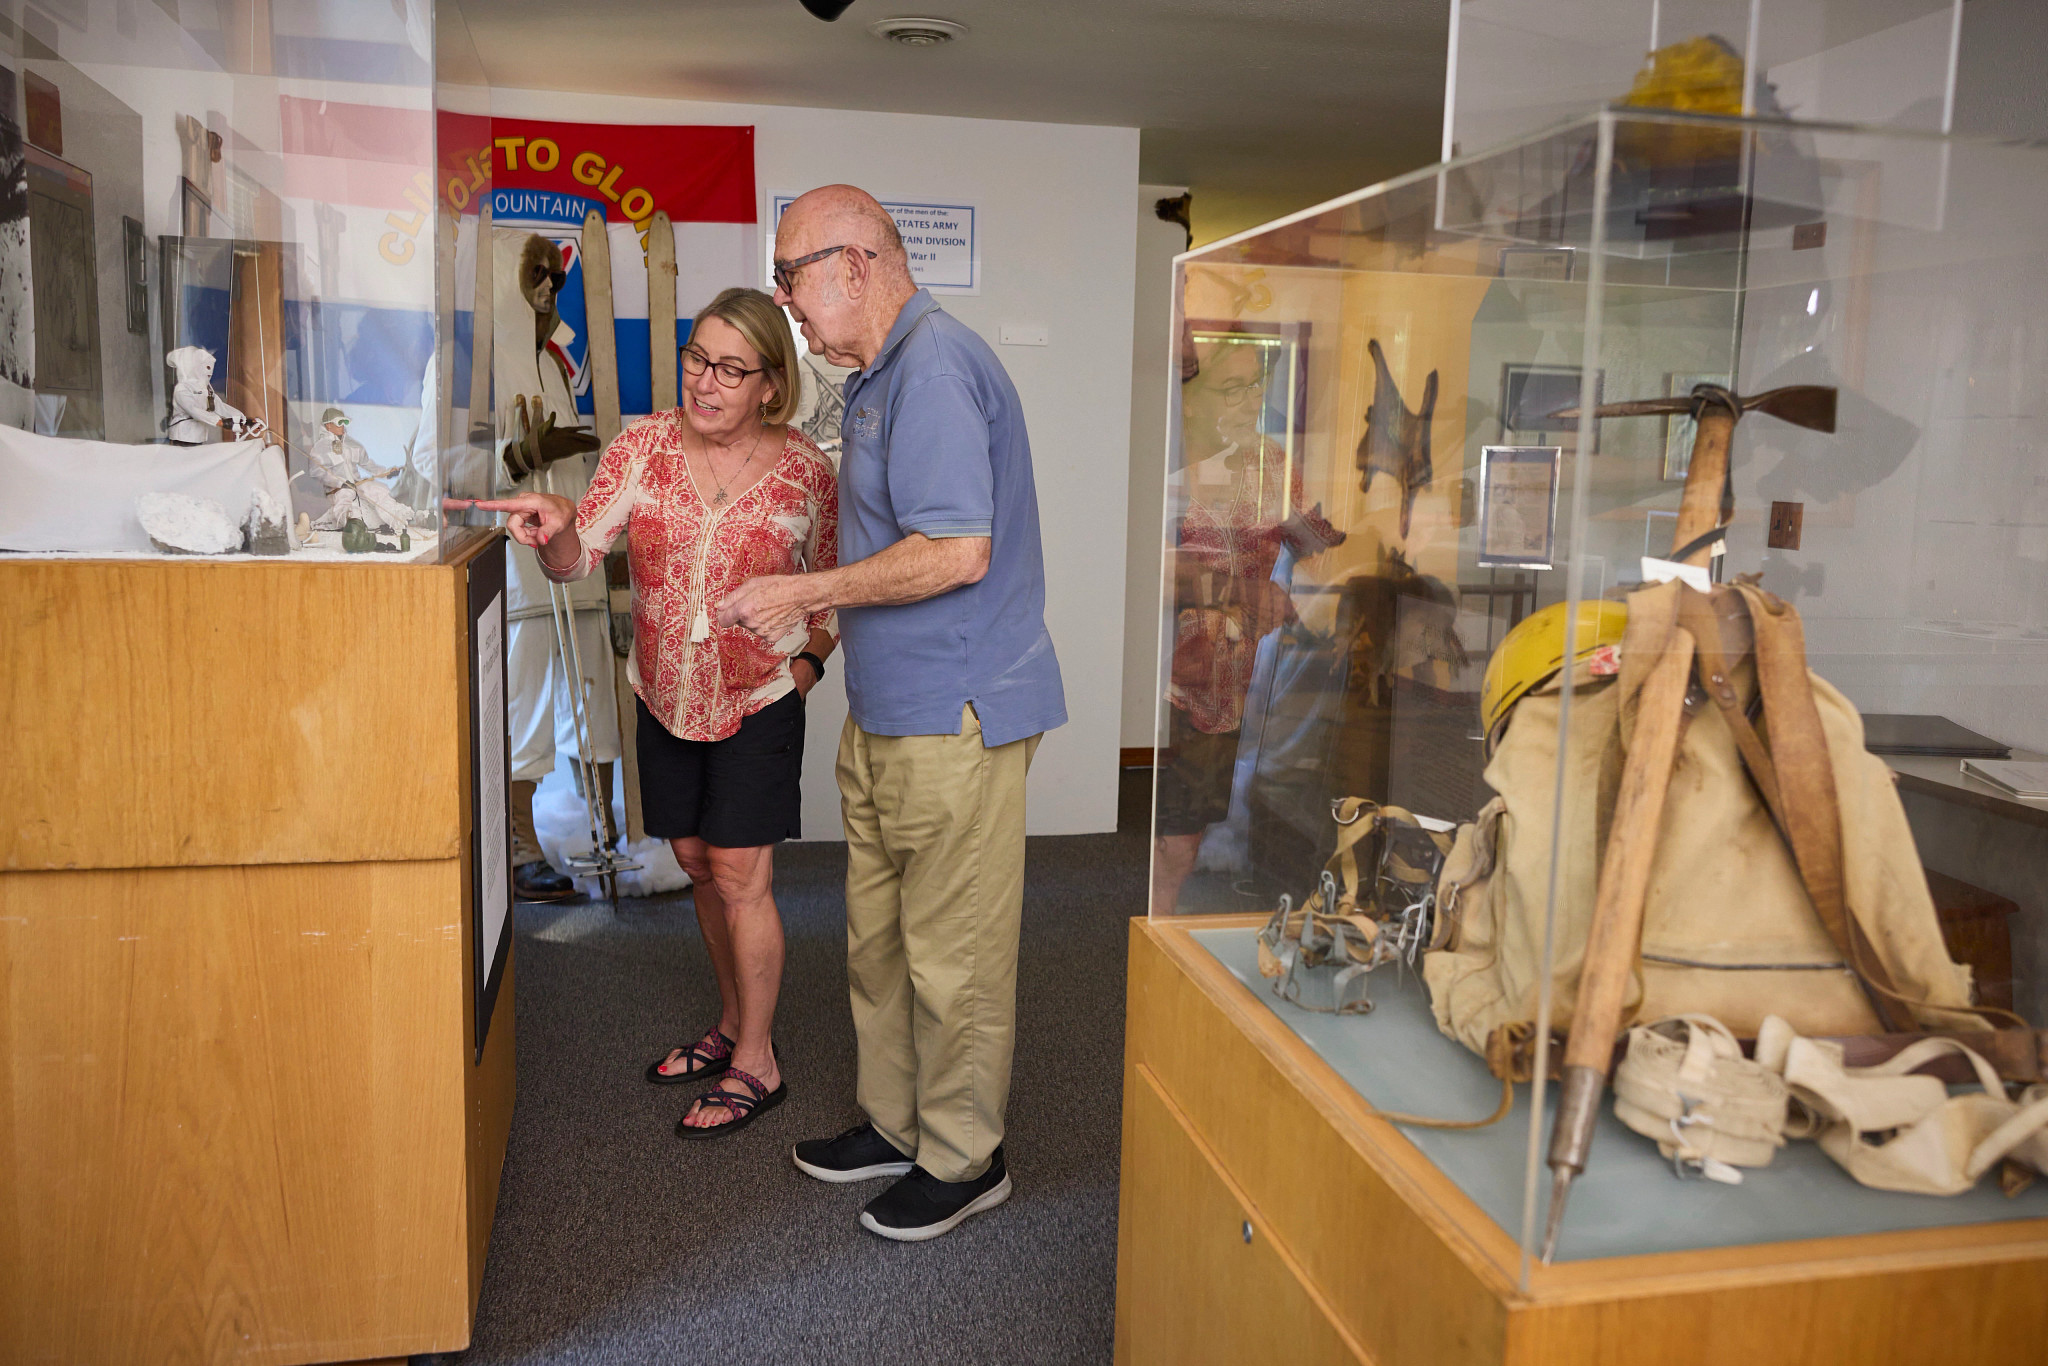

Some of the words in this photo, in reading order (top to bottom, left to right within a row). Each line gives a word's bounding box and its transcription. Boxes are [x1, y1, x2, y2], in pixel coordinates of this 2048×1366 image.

[494, 136, 560, 172] TO
[492, 192, 585, 219] OUNTAIN
[896, 219, 930, 229] STATES
[932, 221, 959, 230] ARMY
[901, 235, 923, 245] TAIN
[925, 237, 966, 246] DIVISION
[910, 252, 927, 260] War
